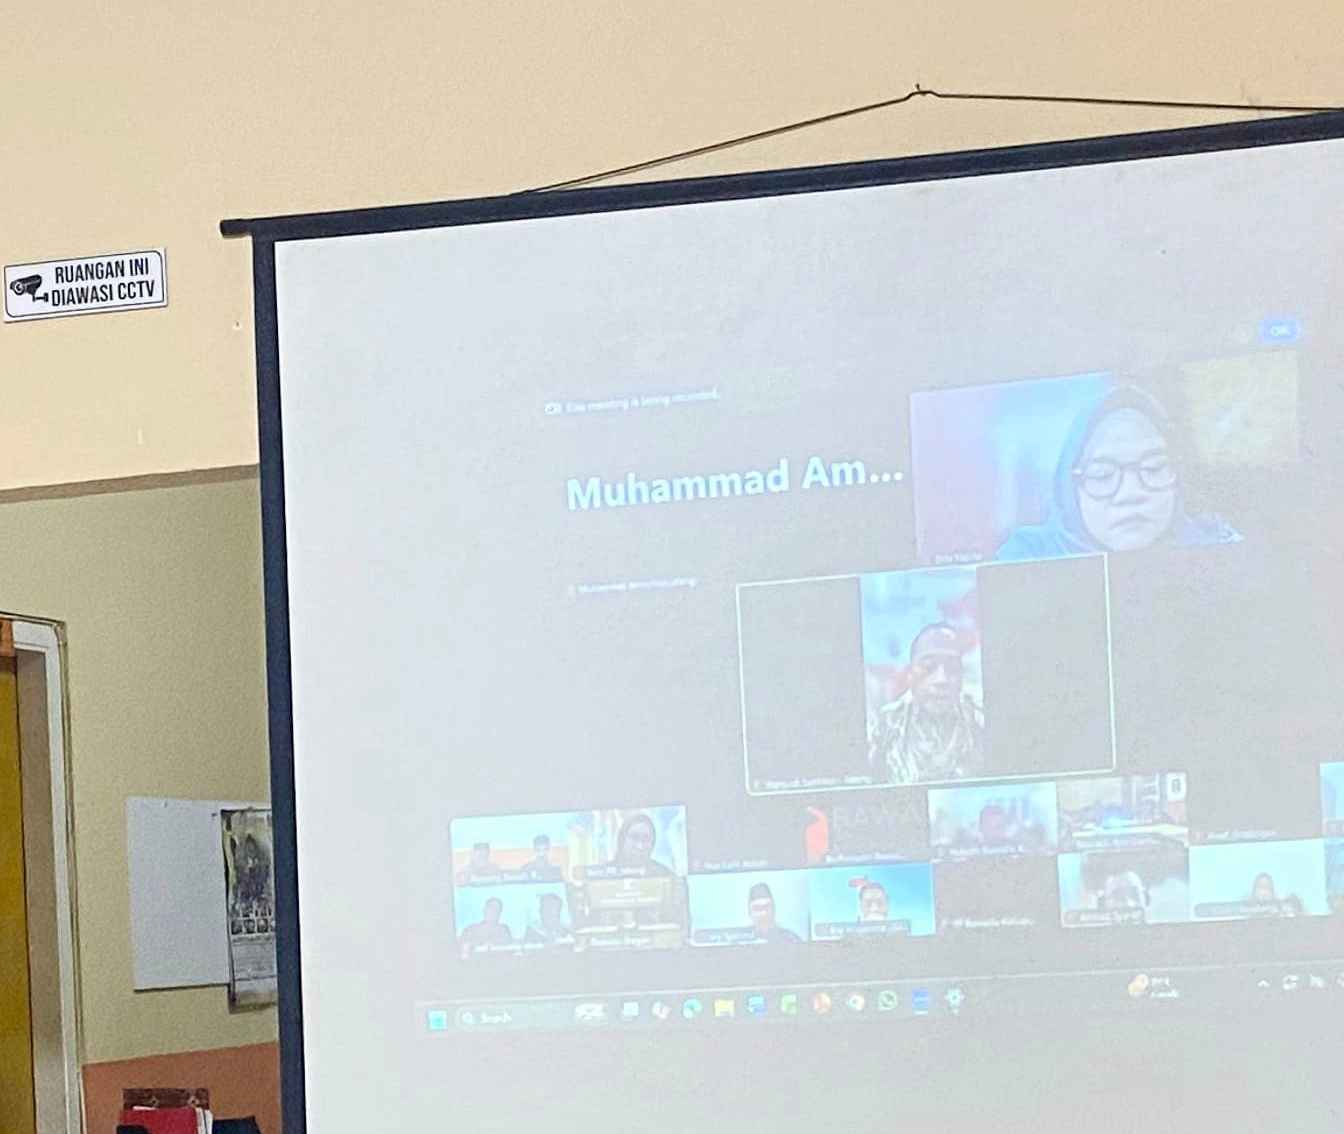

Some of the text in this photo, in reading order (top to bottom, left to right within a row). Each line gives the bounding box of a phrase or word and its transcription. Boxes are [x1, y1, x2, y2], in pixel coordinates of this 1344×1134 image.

[55, 257, 149, 284] RUANGAN INI
[51, 280, 155, 307] DIAWASI CCTV
[566, 455, 905, 511] Muhammad Am...
